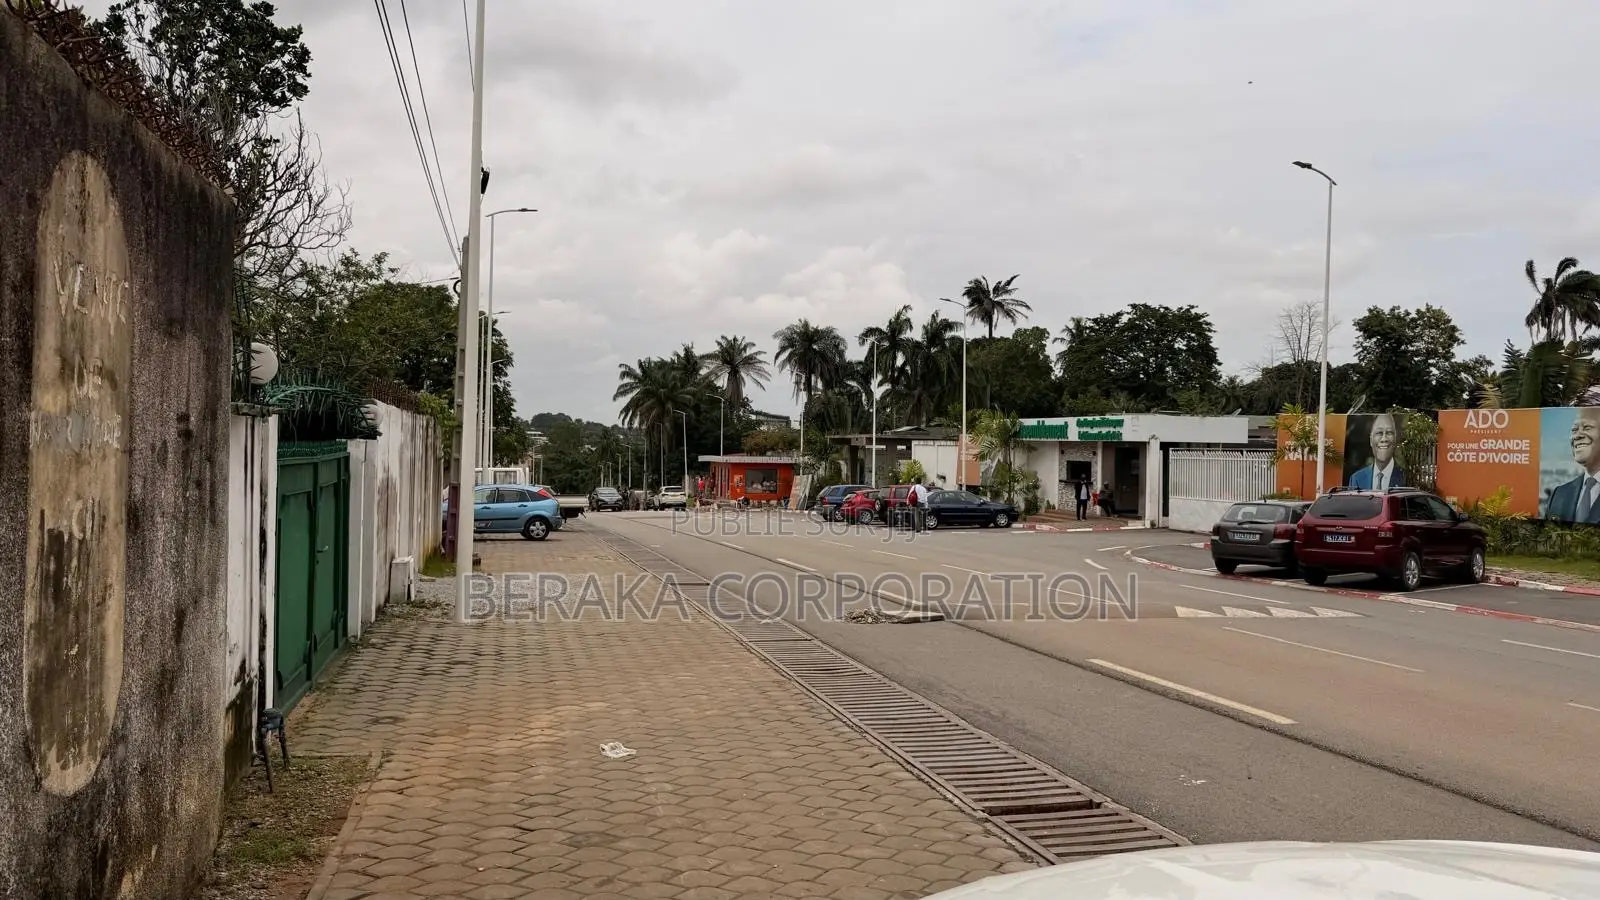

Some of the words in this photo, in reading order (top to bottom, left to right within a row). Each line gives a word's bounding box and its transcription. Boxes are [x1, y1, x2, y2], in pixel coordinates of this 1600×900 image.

[1463, 409, 1509, 429] ADO
[1447, 442, 1465, 450] POUR
[1465, 442, 1479, 450] UNE
[1480, 439, 1530, 450] GRANDE
[1447, 449, 1477, 463] CÔTE
[1478, 452, 1530, 465] D'IVOIRE
